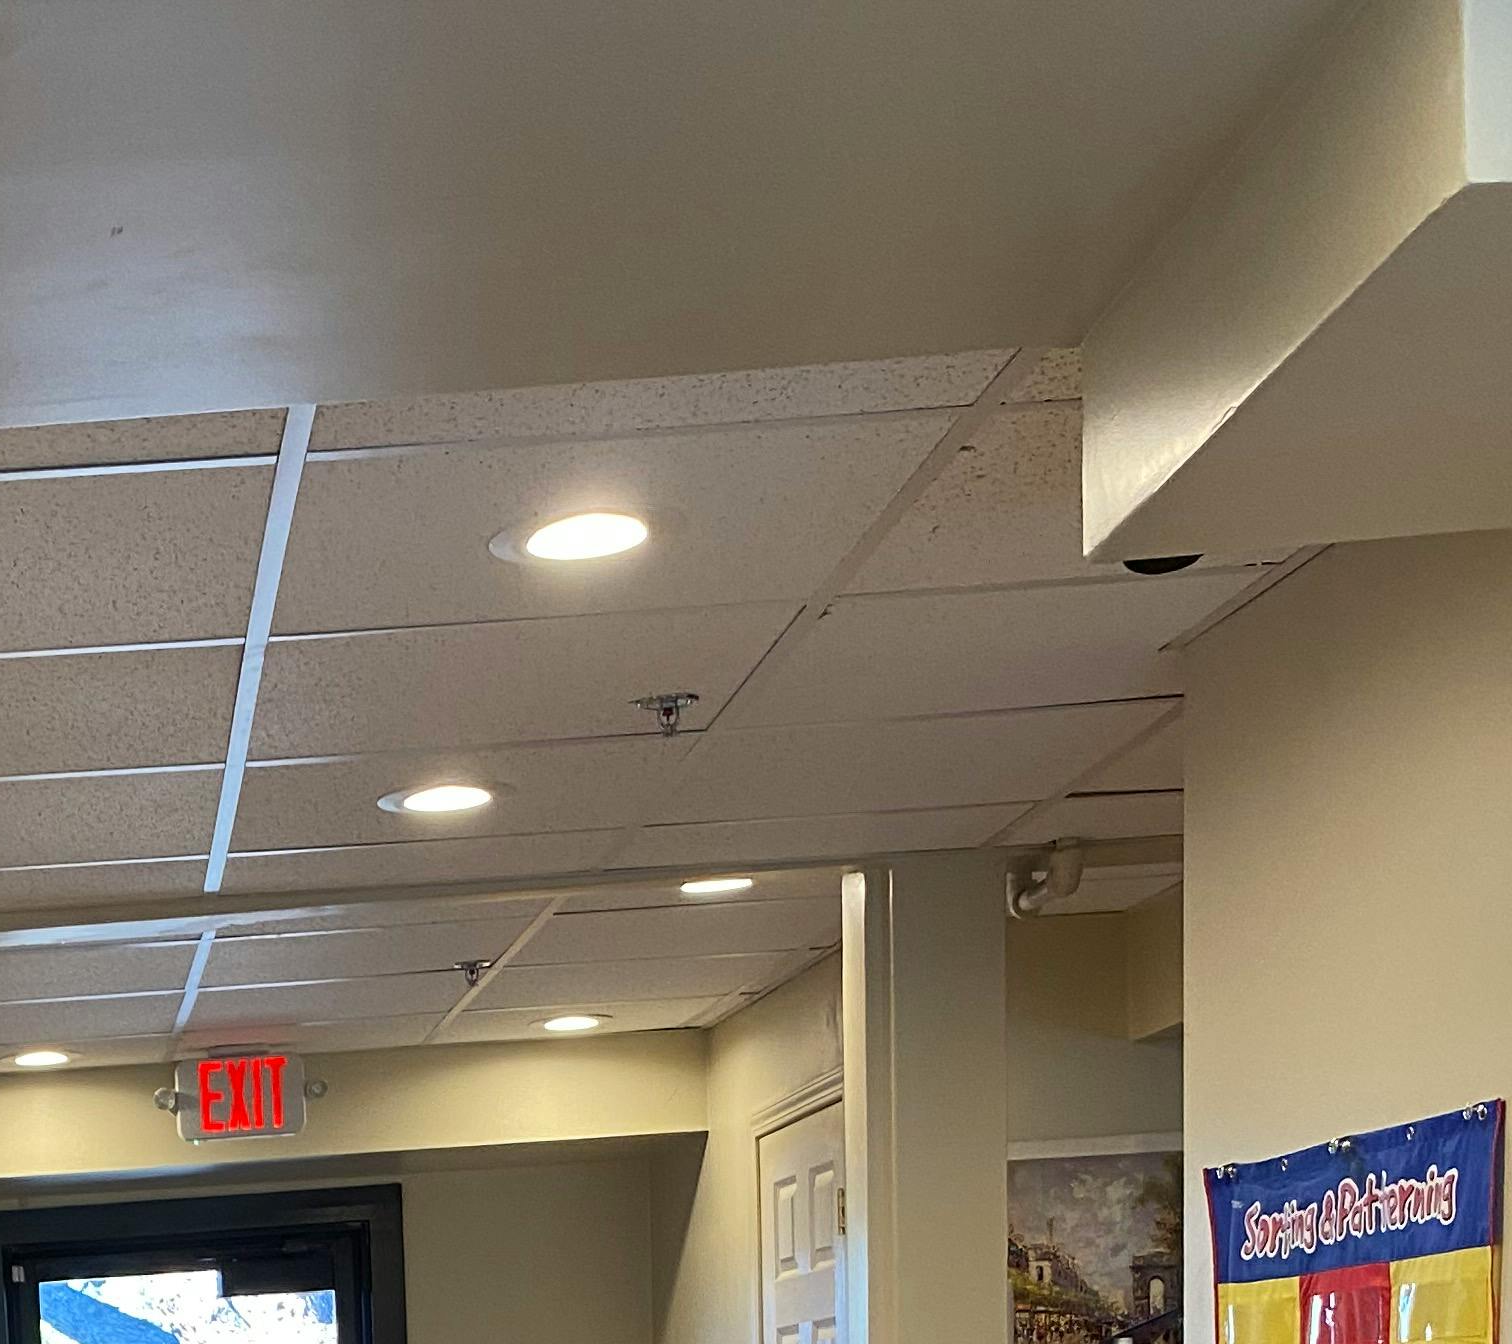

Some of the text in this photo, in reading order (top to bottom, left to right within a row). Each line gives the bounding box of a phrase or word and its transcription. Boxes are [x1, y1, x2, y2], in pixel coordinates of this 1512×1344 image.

[198, 1056, 288, 1132] EXIT
[1241, 1164, 1458, 1260] Sorting & Patterning
